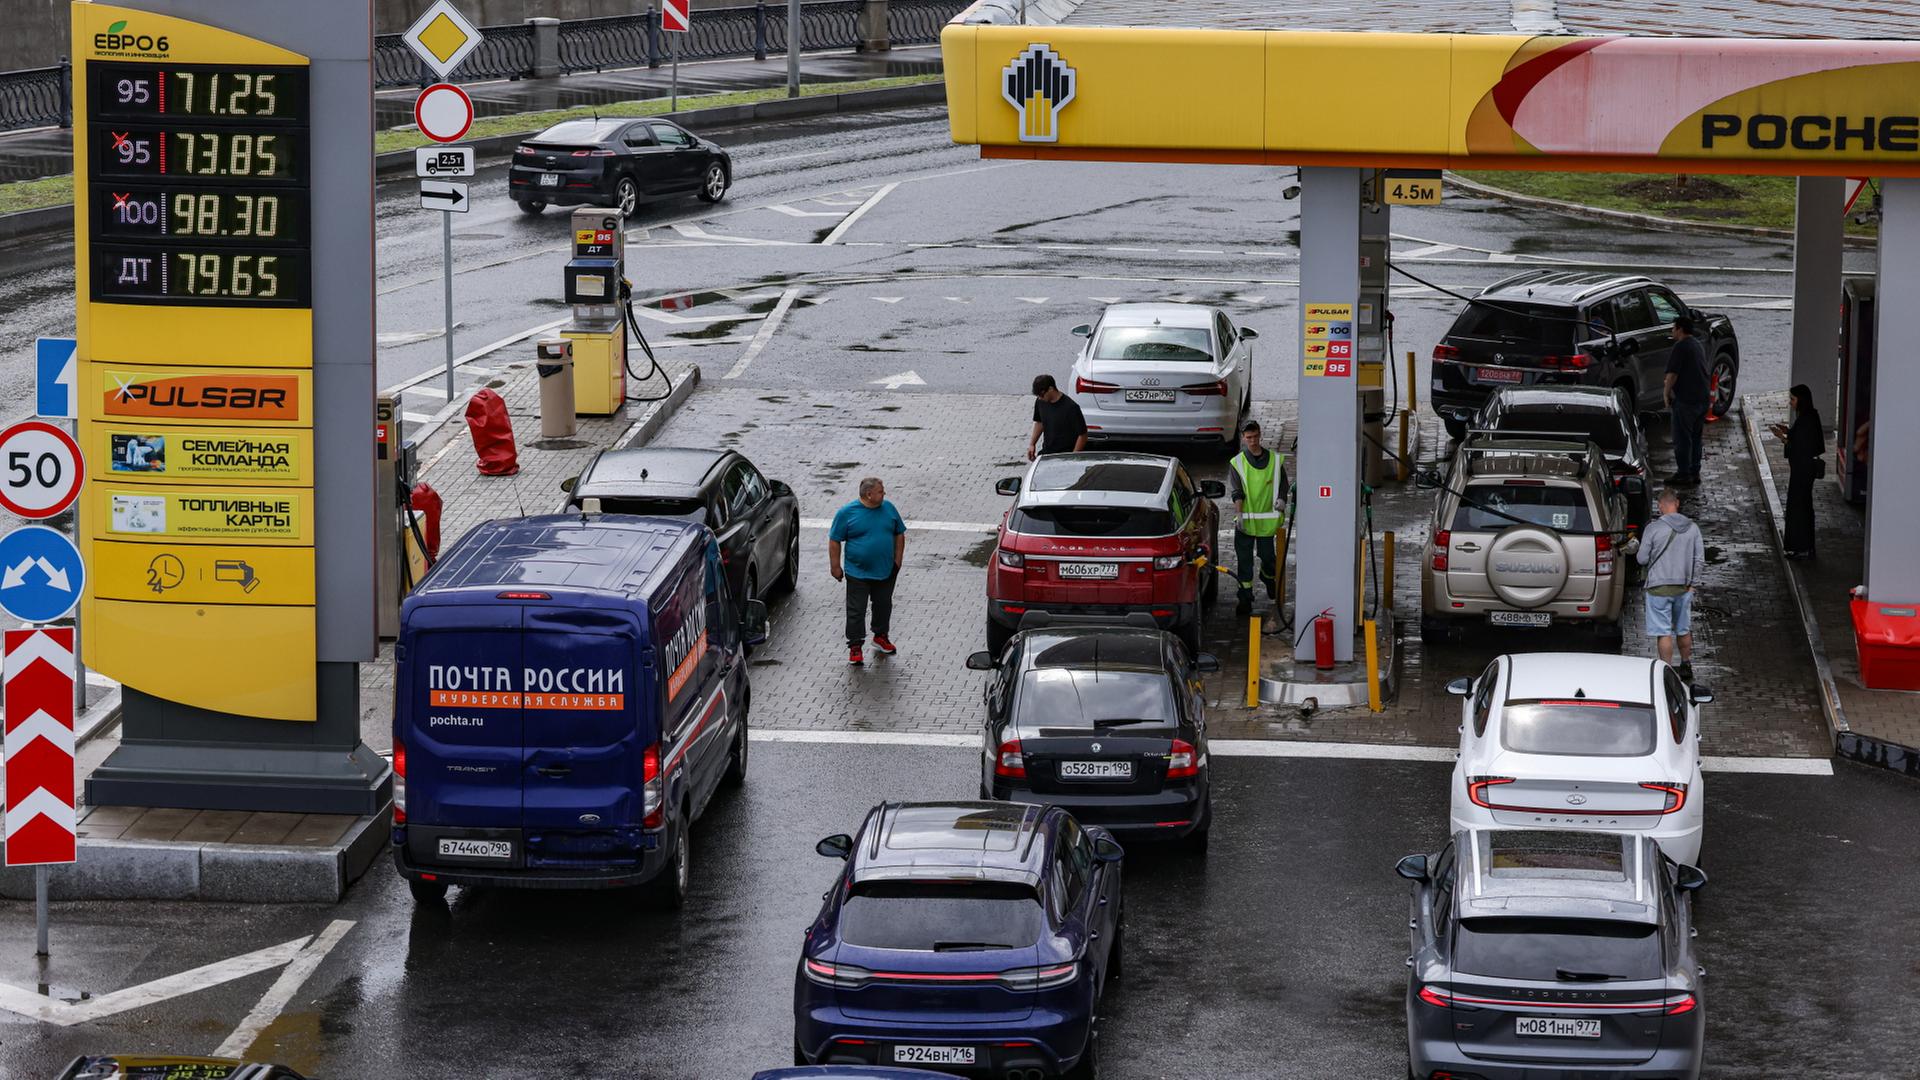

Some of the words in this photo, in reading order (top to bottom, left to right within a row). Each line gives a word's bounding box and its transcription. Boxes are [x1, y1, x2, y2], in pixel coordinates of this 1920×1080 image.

[94, 33, 153, 51] ЕВРО
[157, 36, 169, 51] 6
[117, 80, 149, 103] 95
[176, 73, 275, 116] 71.25
[1702, 114, 1920, 151] РОСНЕ
[118, 140, 150, 164] 95
[176, 133, 276, 176] 73.85
[116, 200, 158, 224] 100
[174, 194, 277, 236] 98.30
[602, 216, 617, 230] 6
[118, 257, 151, 284] ДТ
[178, 254, 277, 296] 79.65
[1331, 346, 1348, 354] 95
[1329, 364, 1345, 372] 95
[378, 403, 391, 421] 5
[182, 440, 289, 454] СЕМЕЙНАЯ
[192, 454, 289, 468] КОМАНДА
[9, 452, 61, 488] 50
[179, 499, 290, 513] ТОПЛИВНЫЕ
[226, 514, 290, 526] КАРТЫ
[1496, 563, 1559, 574] SUZUKI
[430, 665, 511, 691] ПОЧТА
[524, 668, 623, 693] РОССИИ
[440, 693, 543, 706] КУРЬЕРСКАЯ
[550, 697, 617, 707] СЛУЖБА
[430, 715, 484, 727] pochta.ru
